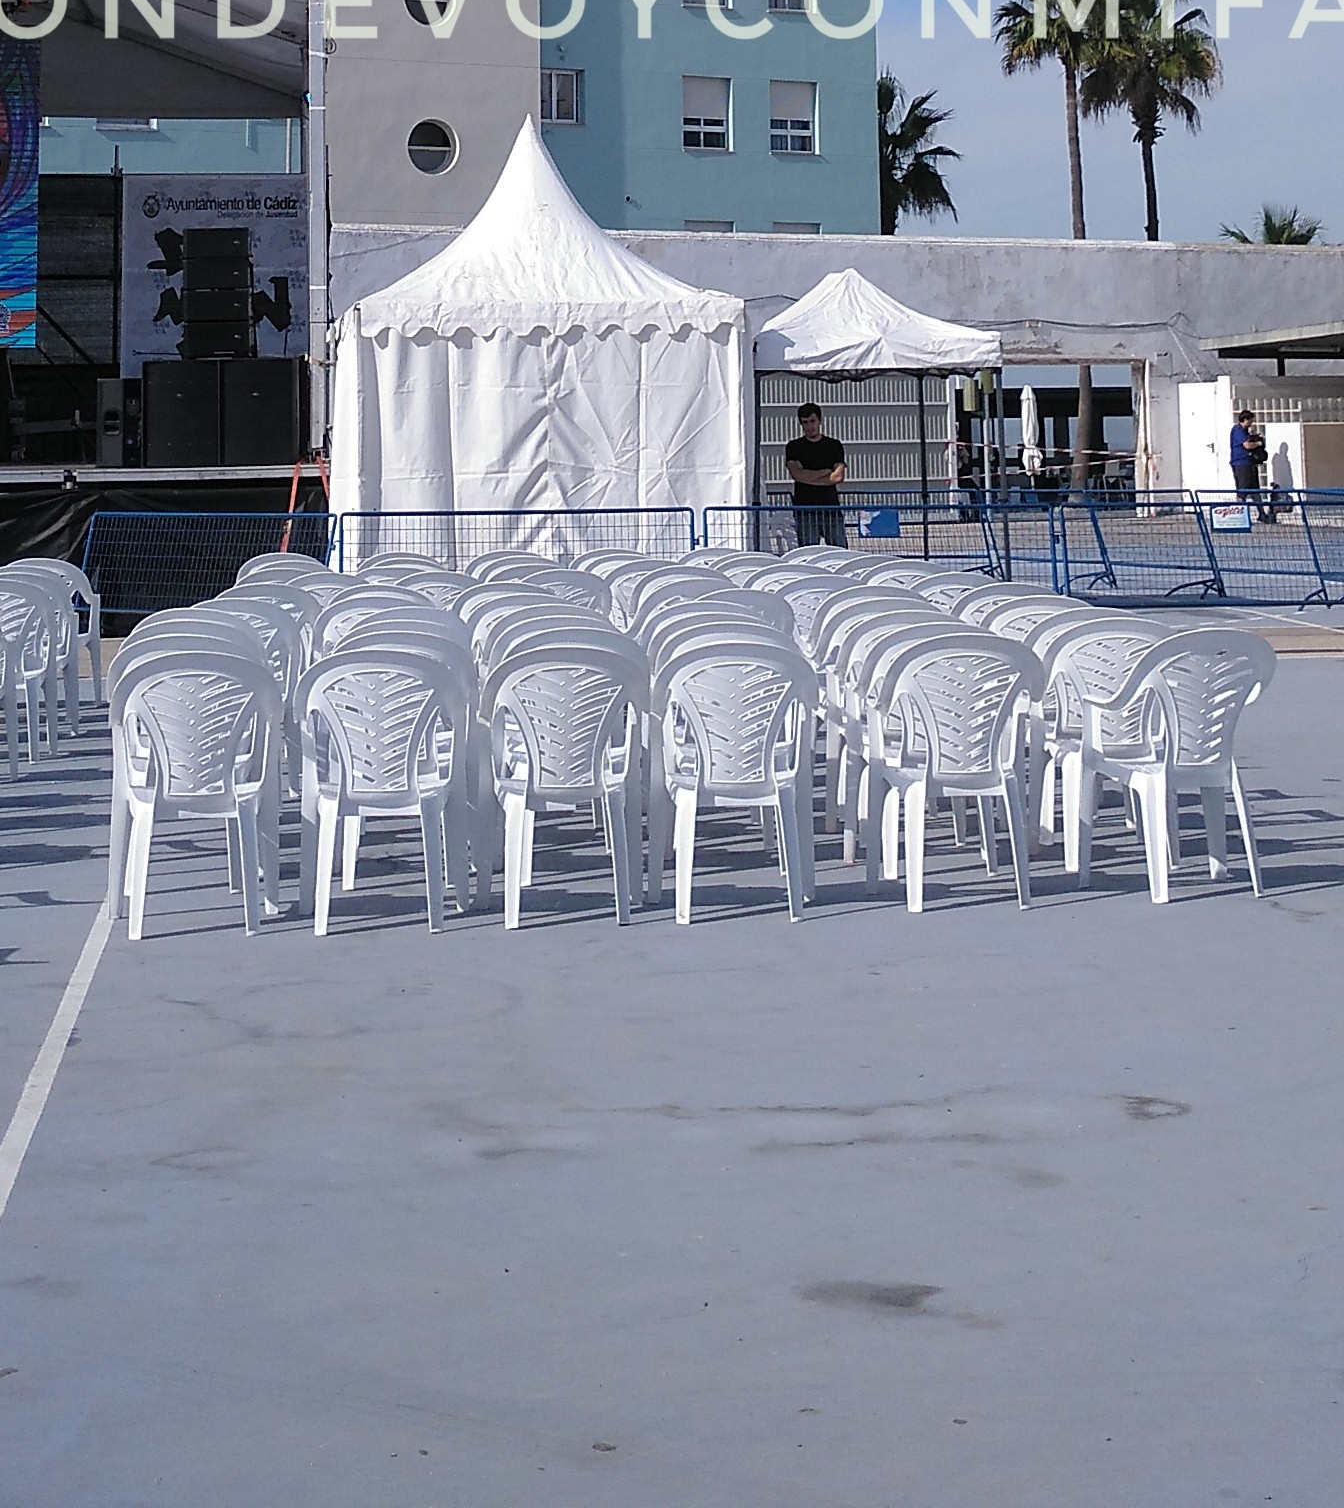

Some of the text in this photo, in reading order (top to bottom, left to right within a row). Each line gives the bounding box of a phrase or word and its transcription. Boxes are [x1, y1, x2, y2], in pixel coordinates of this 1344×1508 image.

[165, 195, 298, 214] Ayuntamiento de Cádiz
